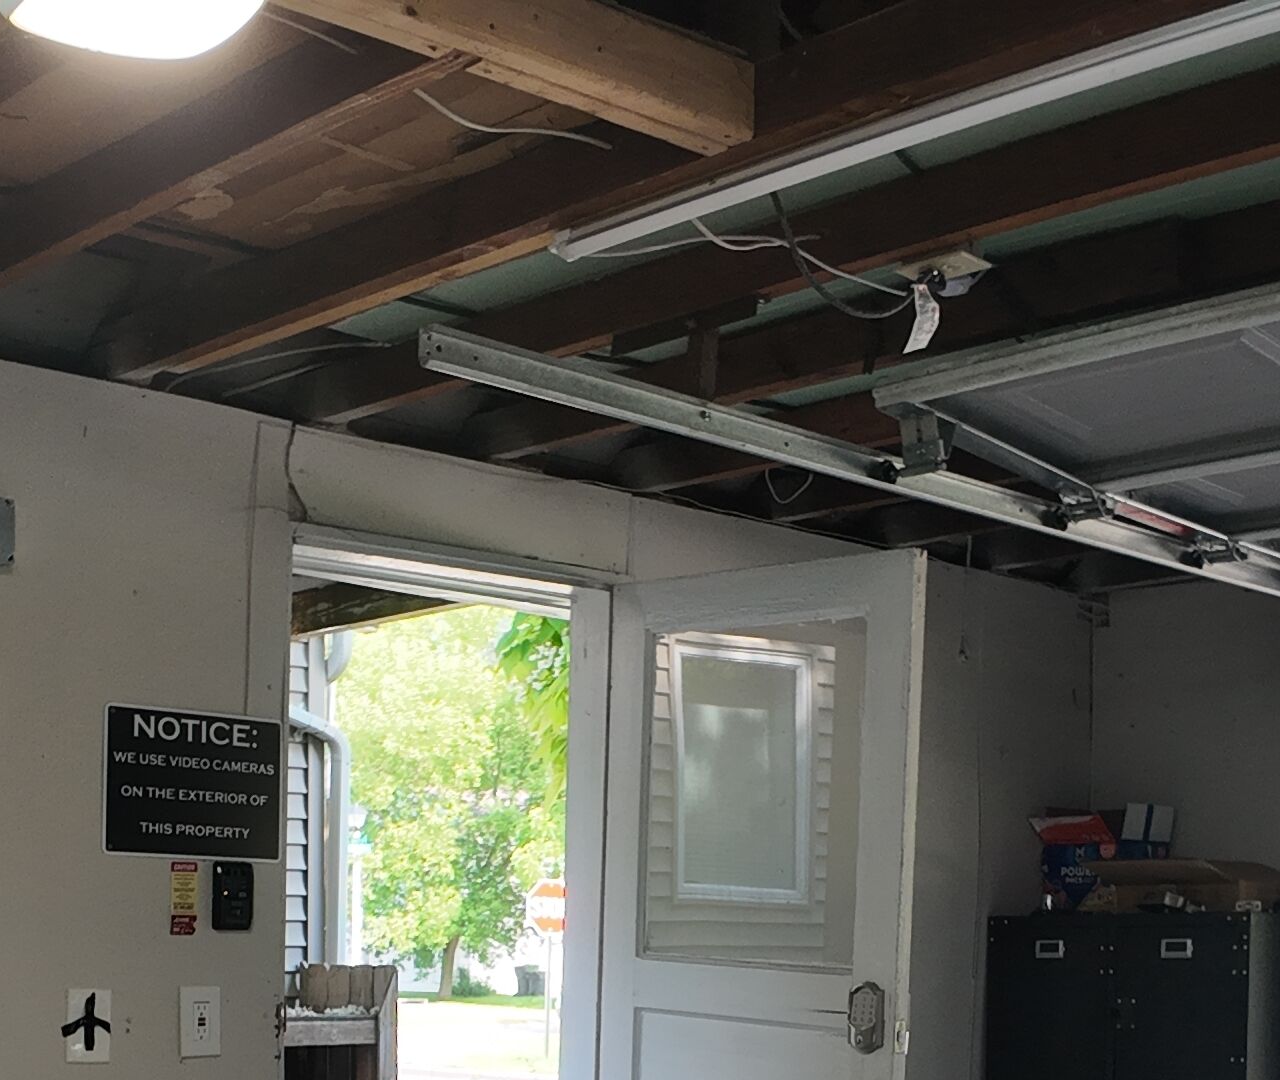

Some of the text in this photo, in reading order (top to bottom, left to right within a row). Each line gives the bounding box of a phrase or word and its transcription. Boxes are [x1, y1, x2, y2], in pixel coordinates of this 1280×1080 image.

[133, 714, 258, 749] NOTICE:
[113, 751, 274, 775] WE USE VIDEO CAMERAS
[120, 785, 268, 806] ON THE EXTERIOR OF
[140, 822, 250, 839] THIS PROPERTY
